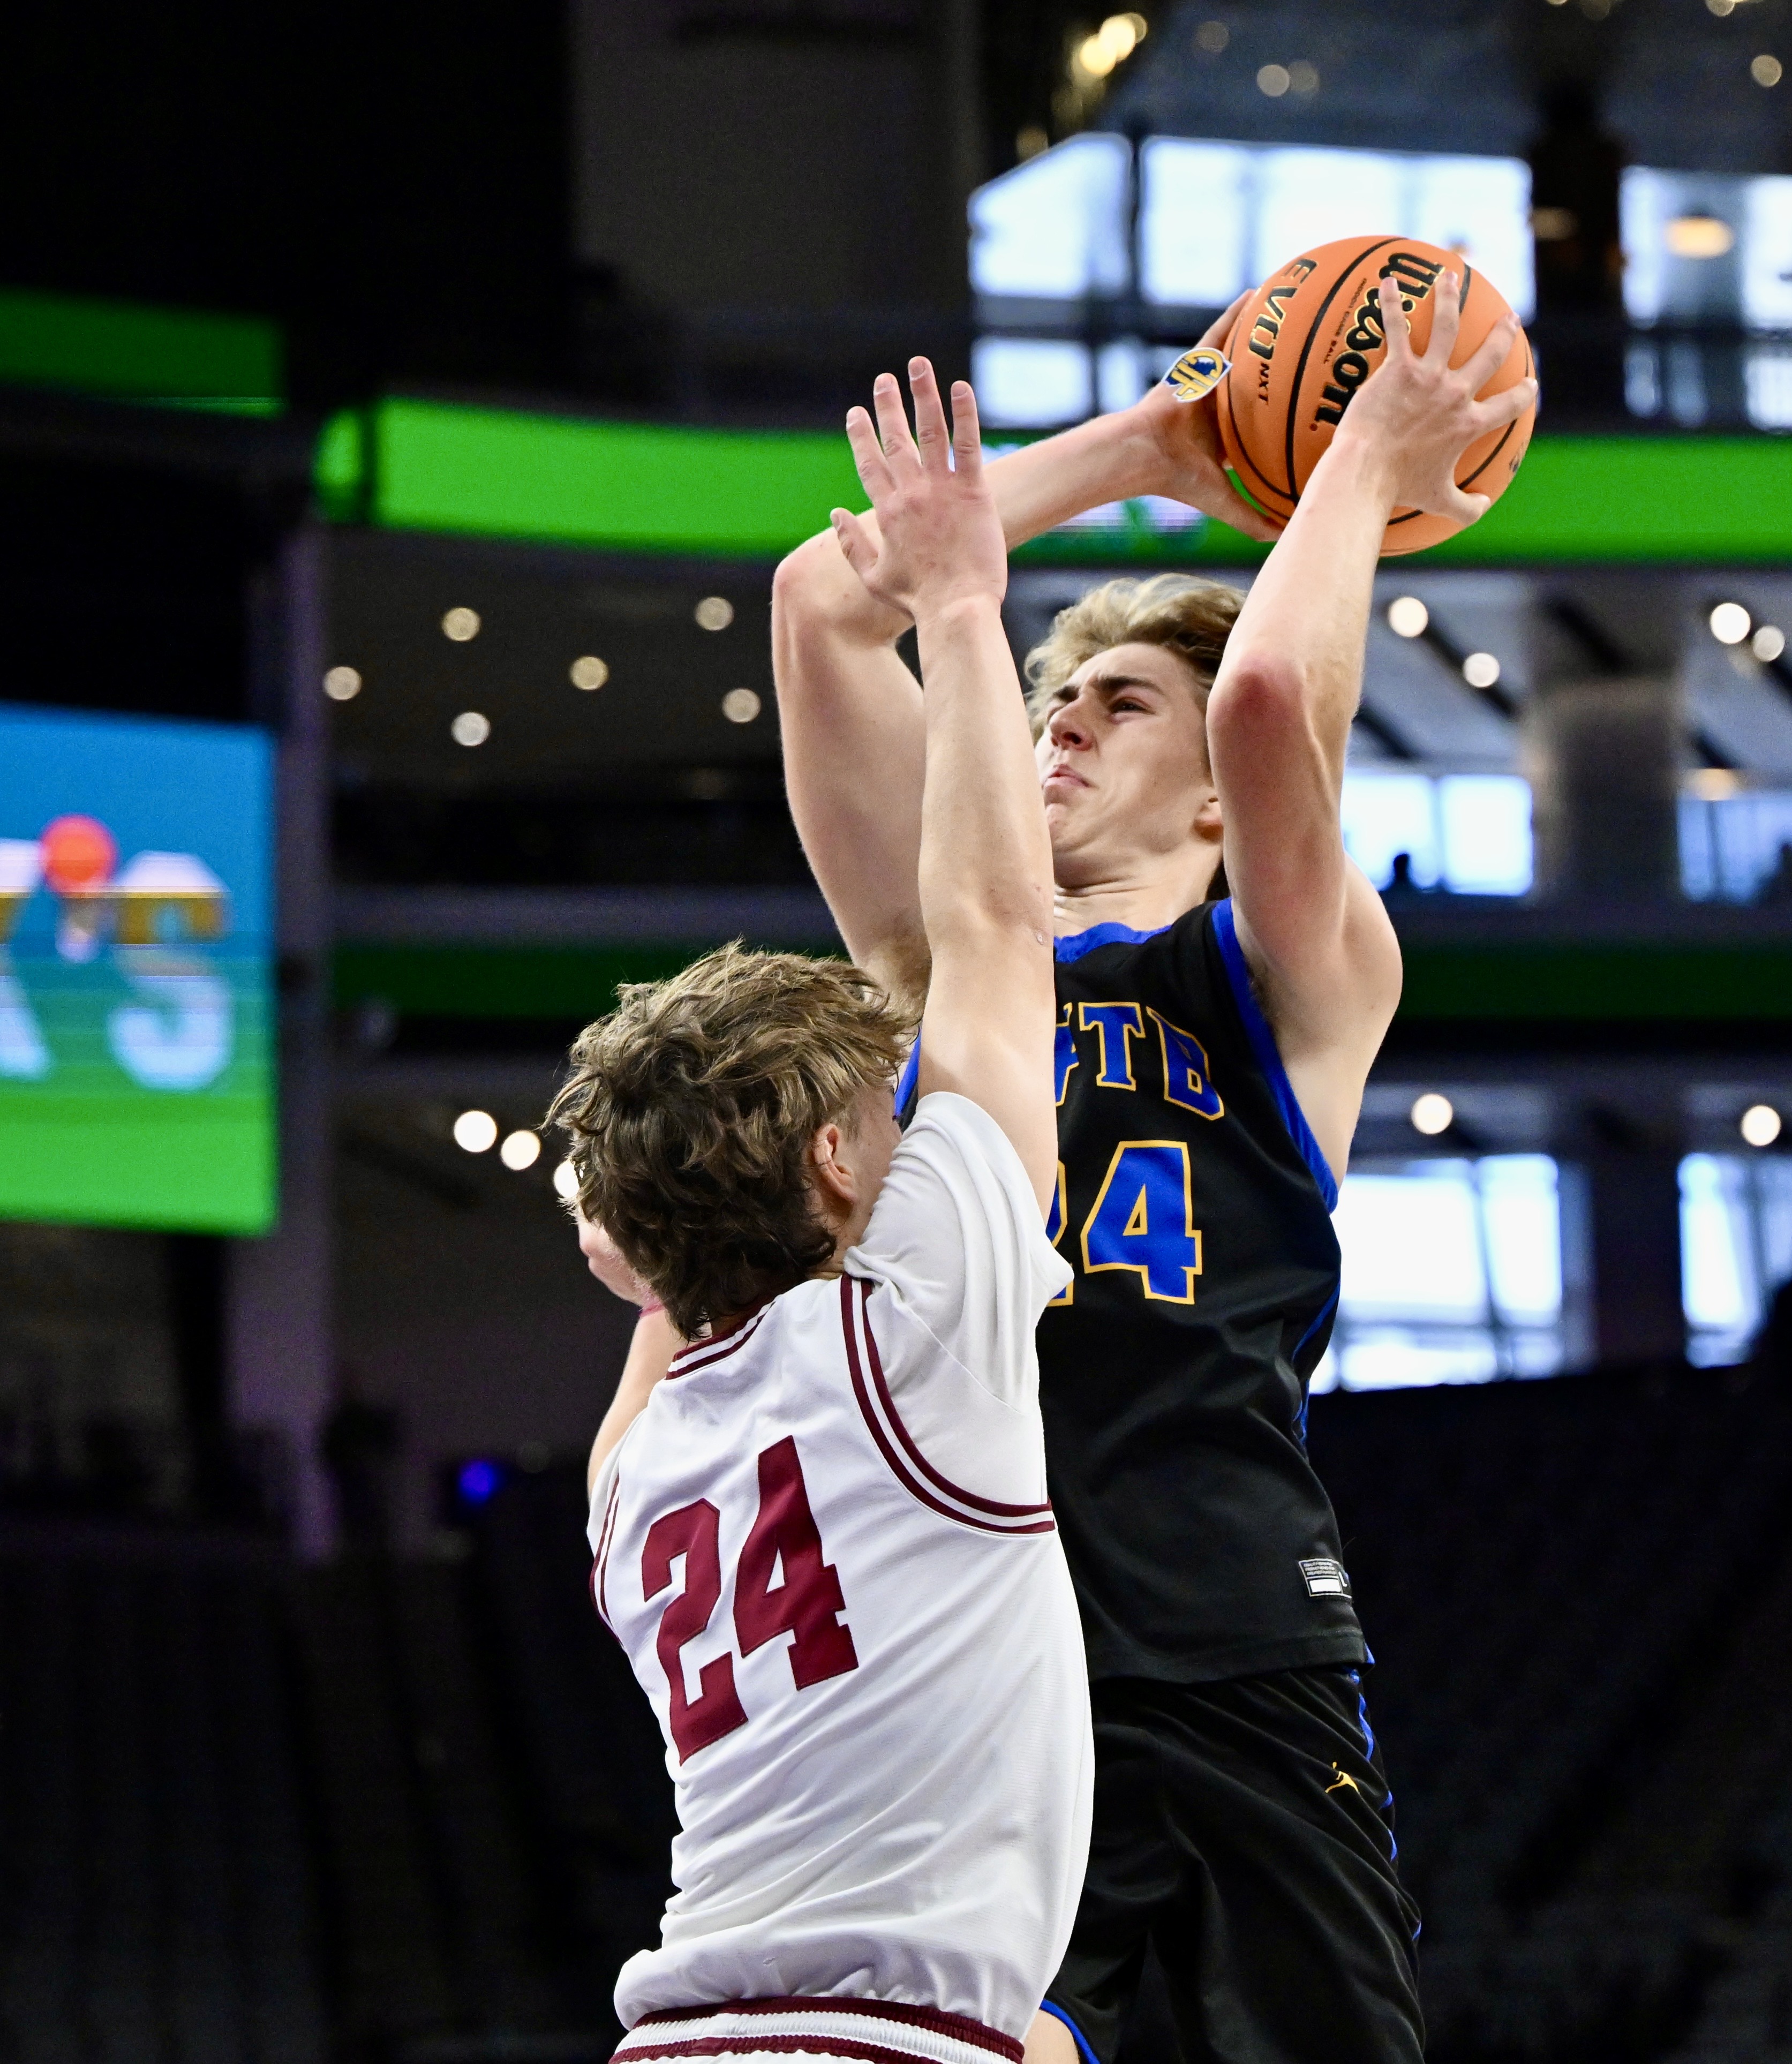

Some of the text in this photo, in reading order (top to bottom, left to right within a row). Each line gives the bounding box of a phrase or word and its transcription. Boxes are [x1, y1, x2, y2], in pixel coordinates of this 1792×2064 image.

[1248, 258, 1318, 405] EVO NXT
[1323, 340, 1337, 364] BALL
[1046, 1140, 1202, 1307] 4
[642, 1435, 859, 1767] 24
